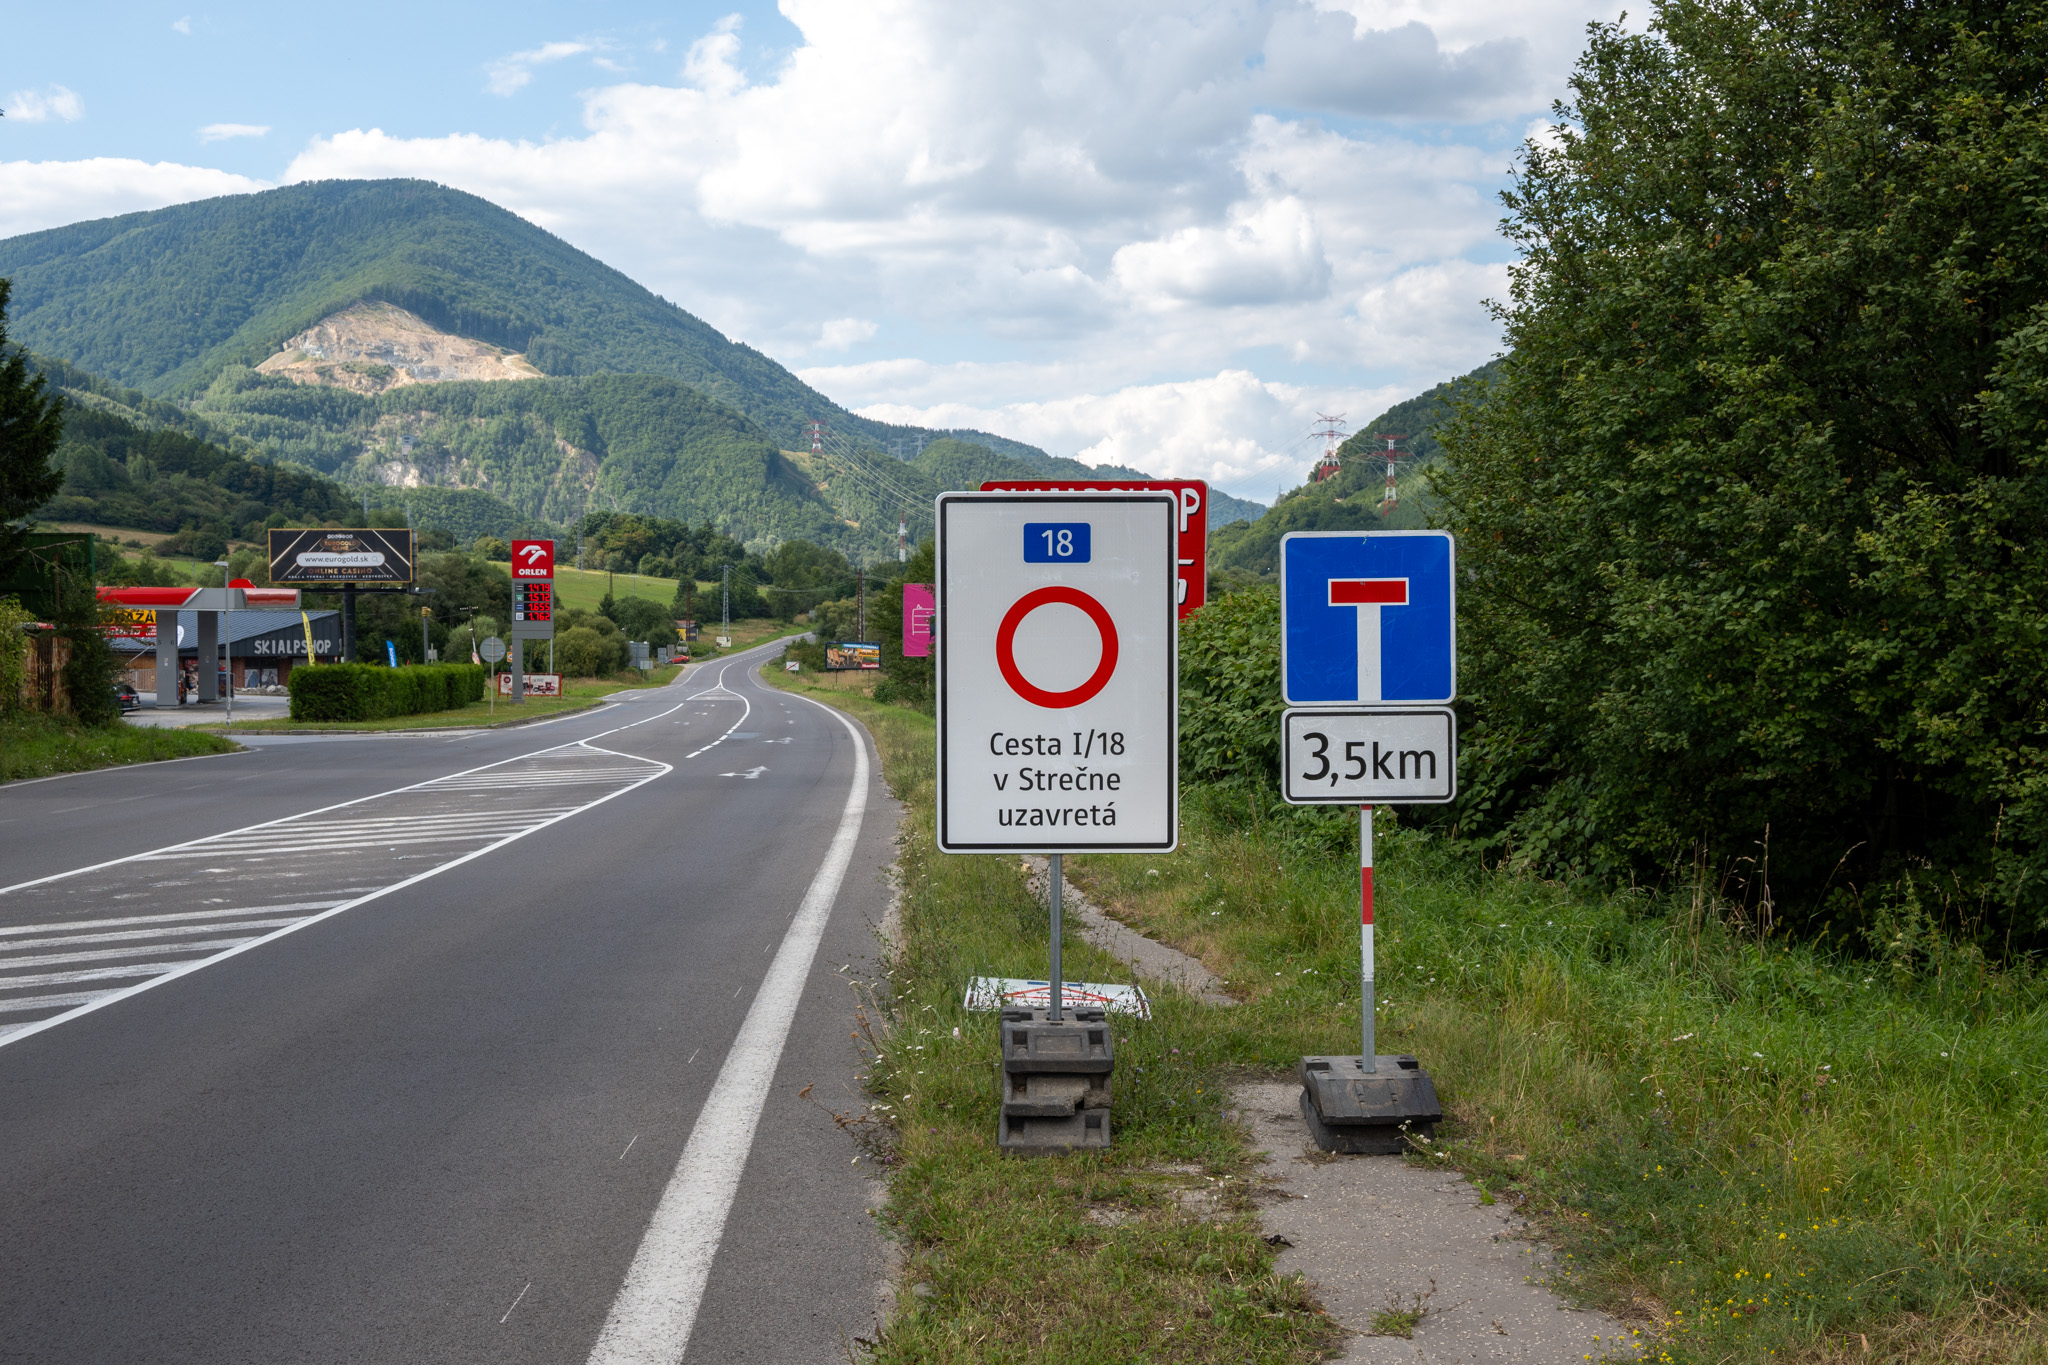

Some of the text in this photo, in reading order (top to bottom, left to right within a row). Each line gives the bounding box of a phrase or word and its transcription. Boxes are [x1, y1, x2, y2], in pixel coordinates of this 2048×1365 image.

[1041, 529, 1074, 557] 18
[305, 555, 368, 564] www.eurogold.sk
[518, 568, 547, 576] ORLEN
[528, 583, 551, 592] 1.479
[528, 593, 551, 602] 1.572
[528, 602, 551, 612] 1.655
[528, 612, 551, 621] 1.762
[990, 729, 1125, 758] Cesta I/18
[1302, 732, 1436, 787] 3,5km
[993, 766, 1121, 791] v Strečne
[998, 801, 1116, 826] uzavretá
